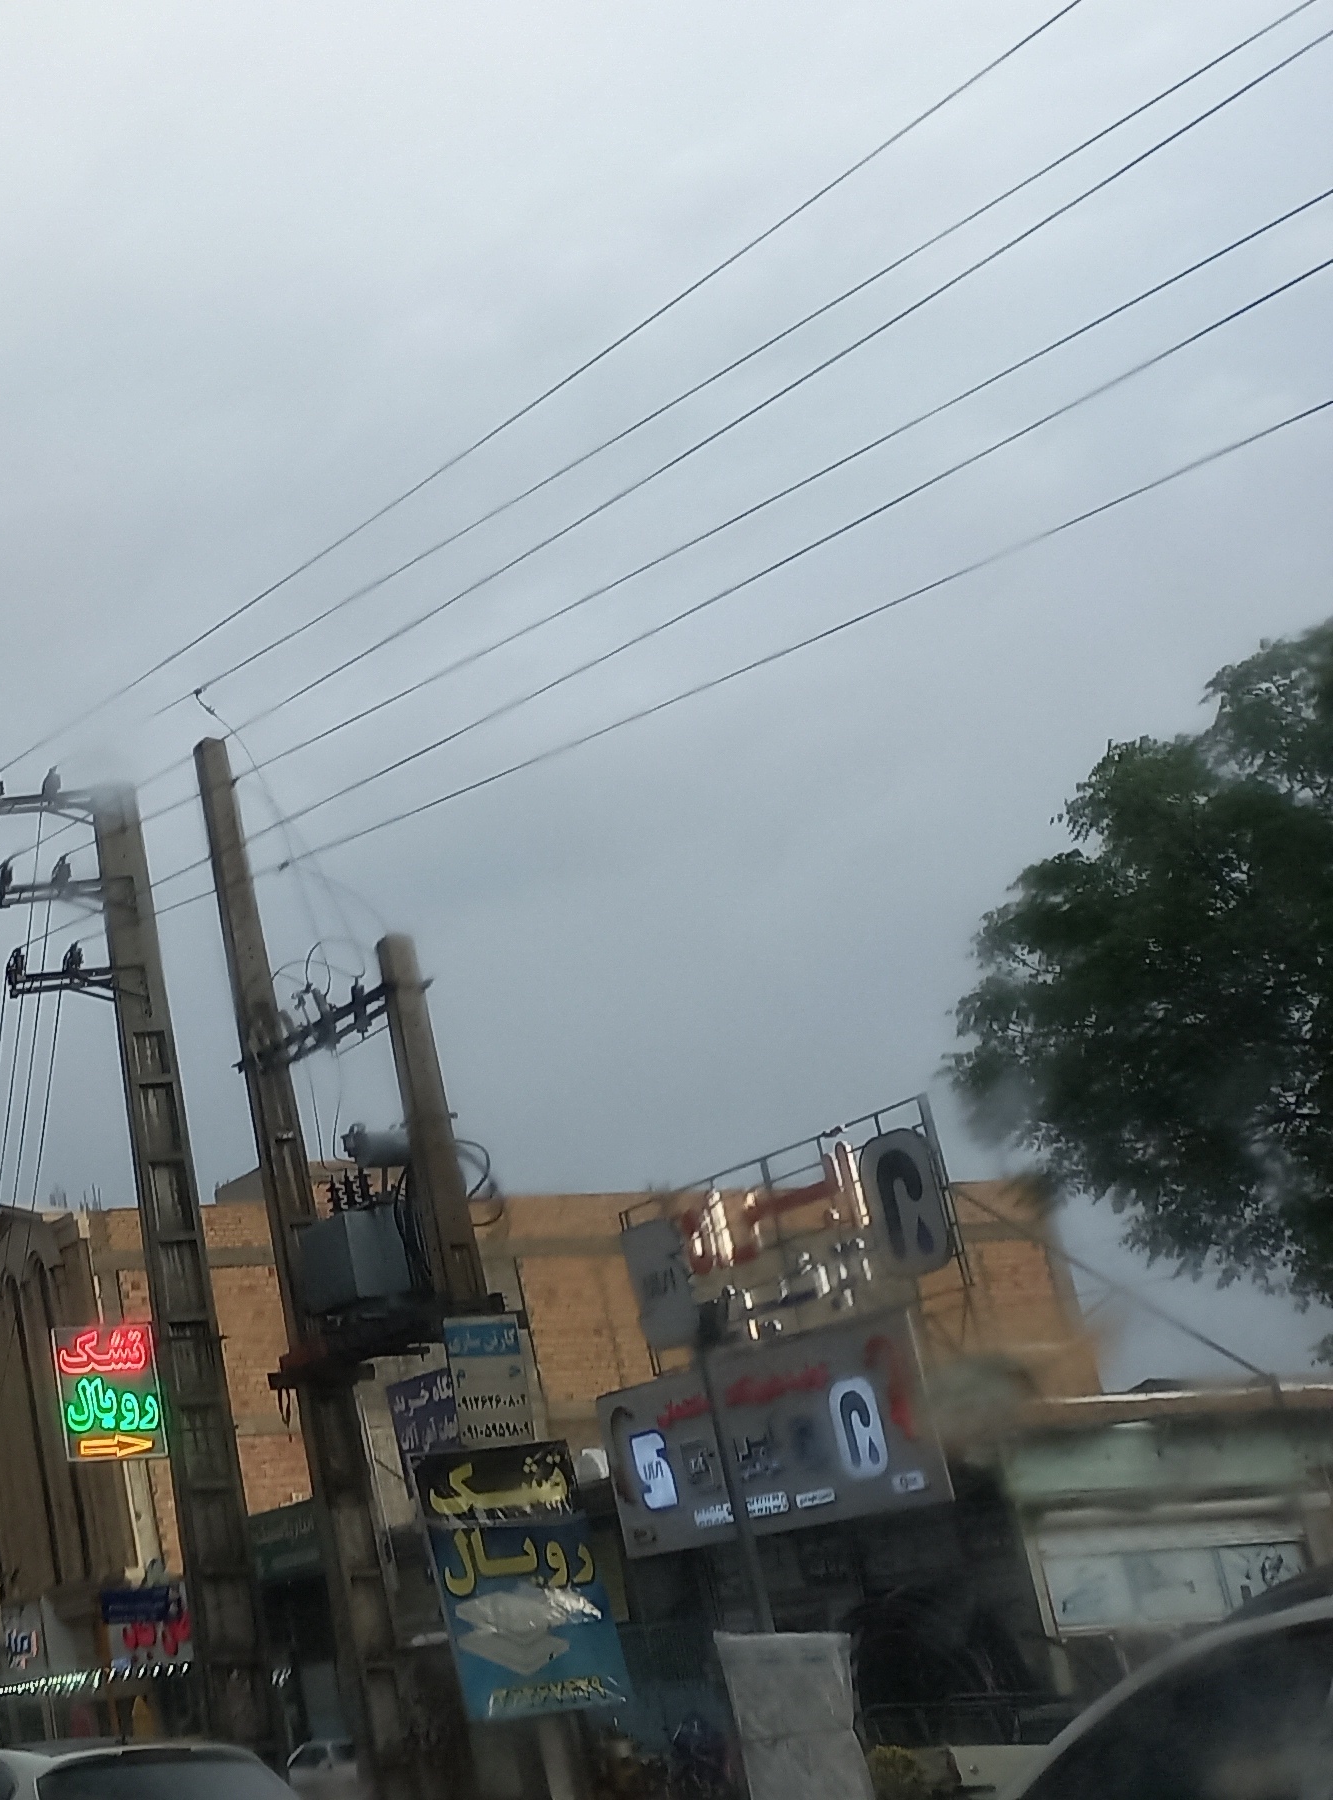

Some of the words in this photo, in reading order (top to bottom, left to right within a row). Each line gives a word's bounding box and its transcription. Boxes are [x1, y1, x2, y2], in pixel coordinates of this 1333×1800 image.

[58, 1329, 147, 1375] تشک
[66, 1376, 161, 1432] رویال
[429, 1453, 574, 1515] تشک
[444, 1527, 596, 1596] رویال
